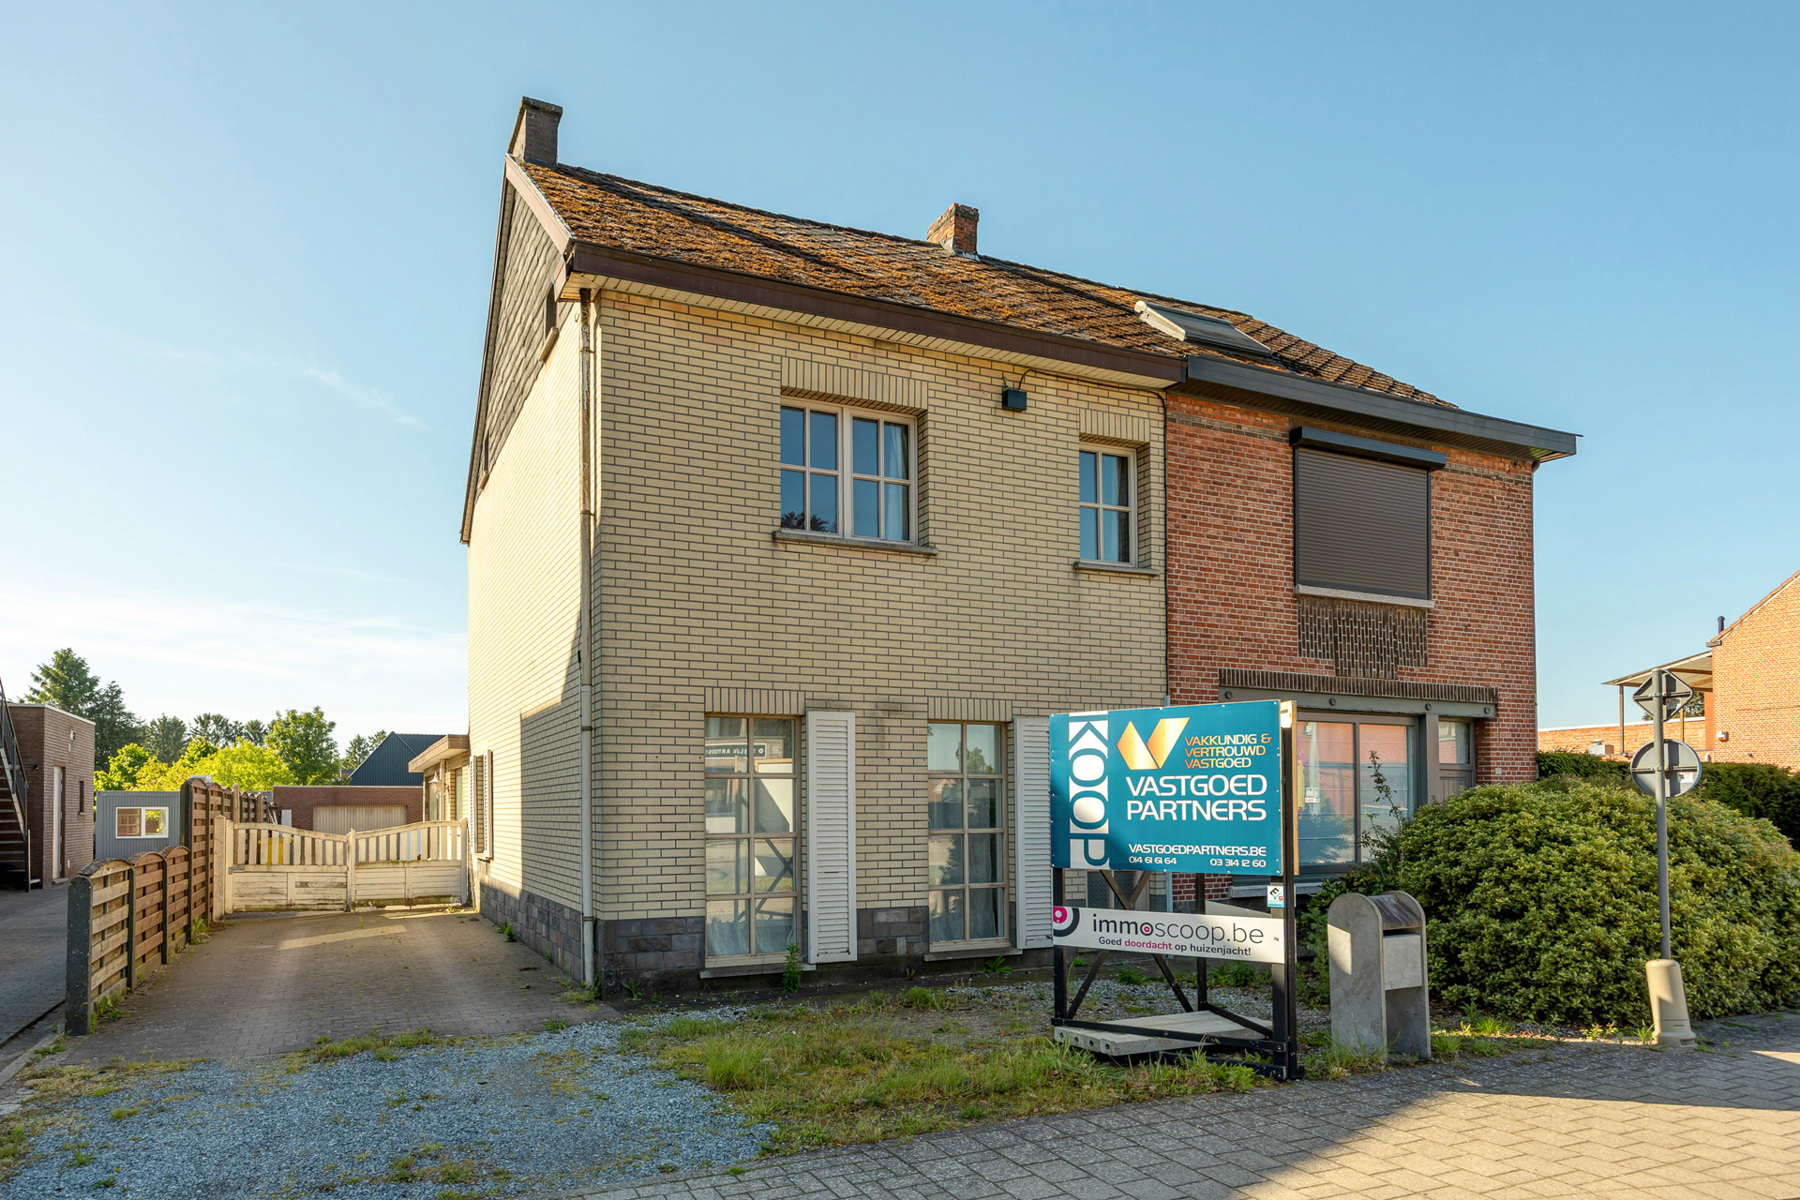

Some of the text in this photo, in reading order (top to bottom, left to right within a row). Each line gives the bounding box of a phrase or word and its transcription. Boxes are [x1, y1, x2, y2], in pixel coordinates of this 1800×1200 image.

[1184, 733, 1272, 747] VAKKUNDIG &
[1184, 745, 1266, 758] VERTROUWD
[1184, 757, 1251, 769] VASTGOED
[1069, 712, 1109, 867] KOOP
[1125, 774, 1268, 797] VASTGOED
[1127, 799, 1267, 821] PARTNERS
[1128, 843, 1266, 857] VASTGOEDPARTNERS.BE
[1128, 856, 1143, 864] 014
[1164, 857, 1177, 865] 64
[1210, 858, 1267, 868] 03 314 12 60
[1092, 913, 1264, 945] immoscoop.be
[1098, 936, 1251, 956] Goed doordacht op huizenjacht!
